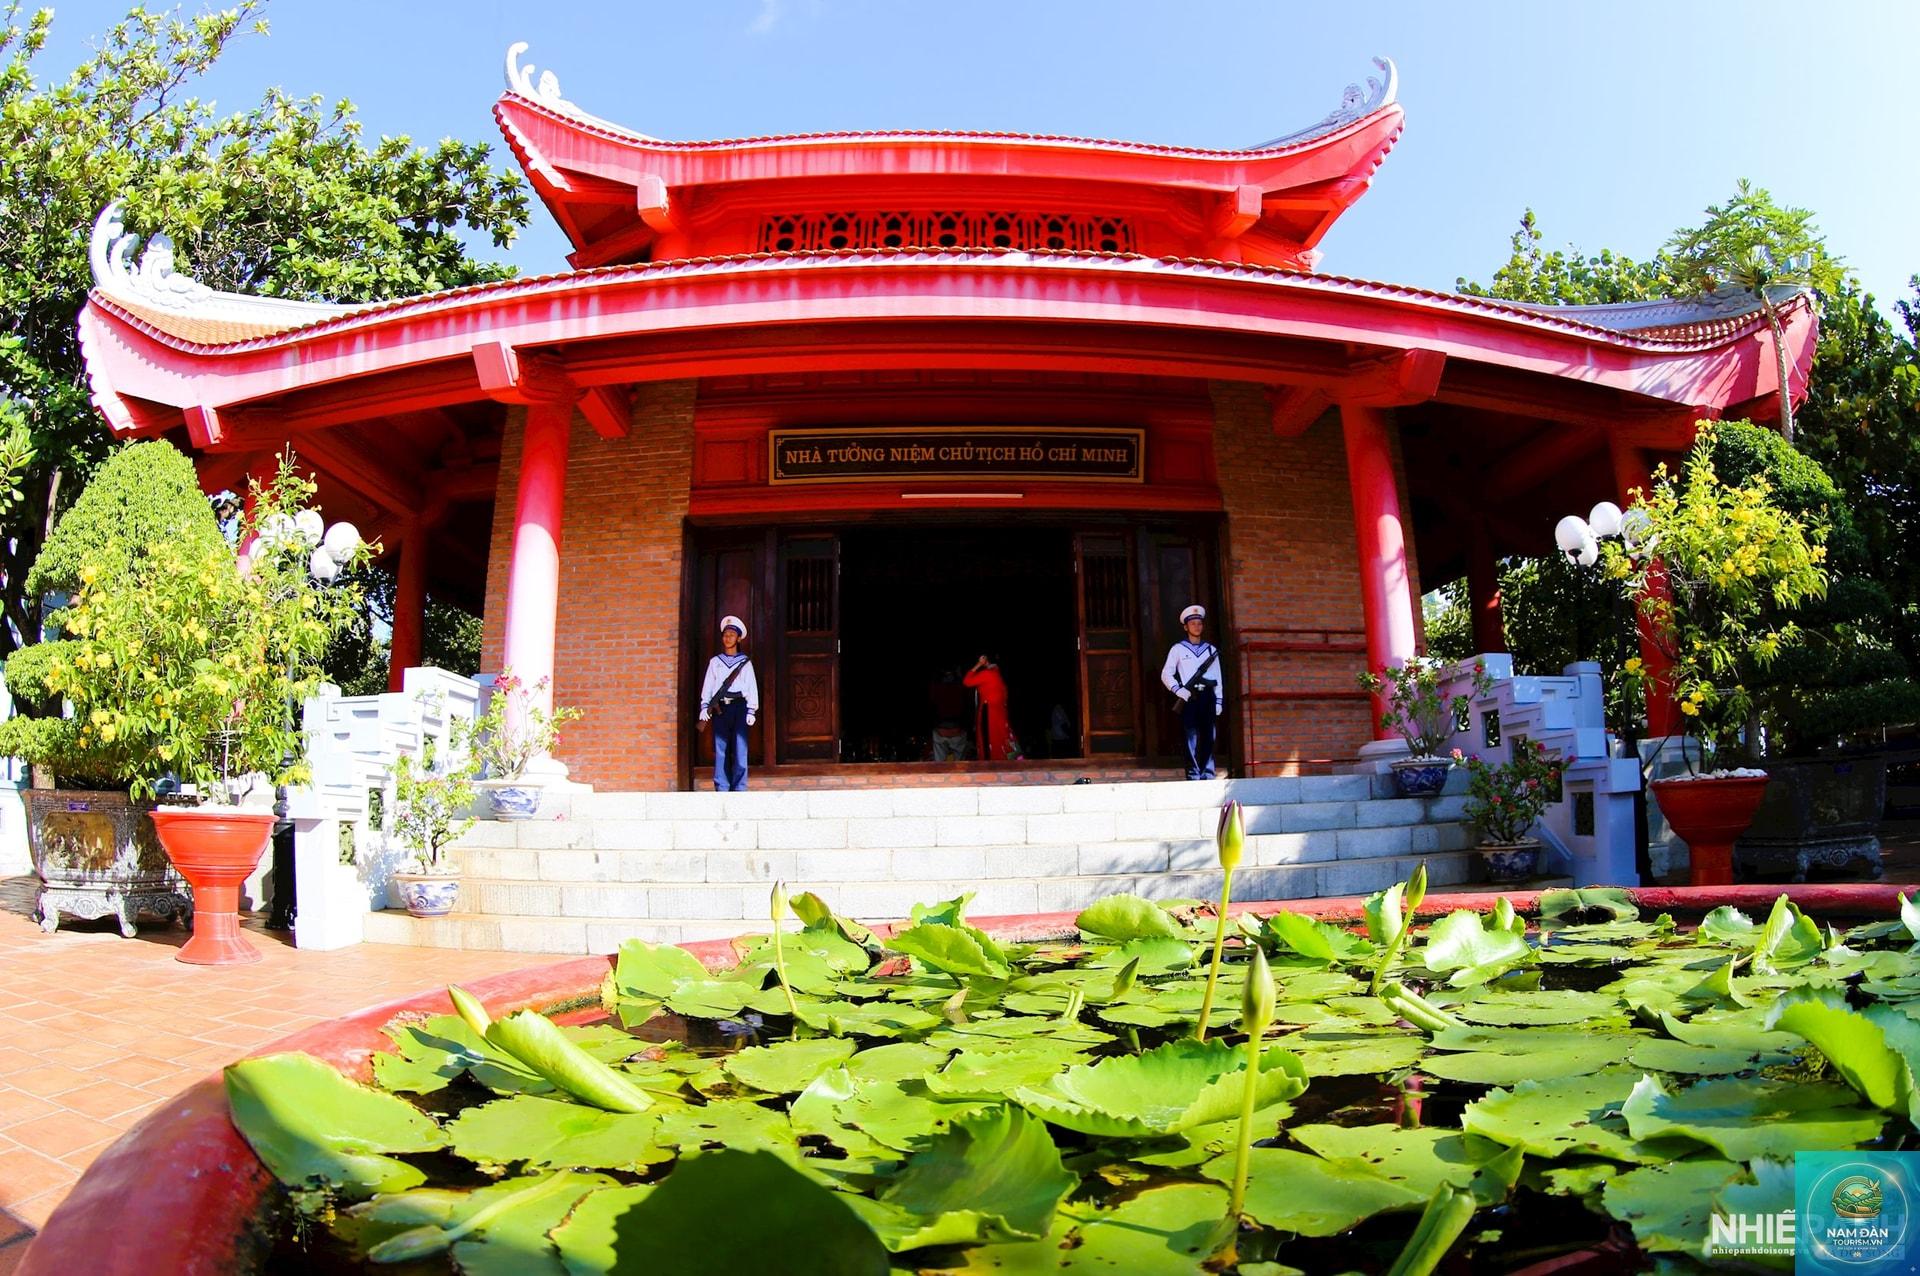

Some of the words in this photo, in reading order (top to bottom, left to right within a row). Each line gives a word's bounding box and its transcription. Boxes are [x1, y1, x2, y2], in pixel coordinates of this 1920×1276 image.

[786, 446, 823, 464] NHÀ
[890, 443, 935, 464] NIỆM
[938, 441, 973, 461] CHỦ
[975, 447, 1016, 464] TỊCH
[1048, 443, 1077, 462] CHÍ
[1082, 447, 1129, 462] MINH
